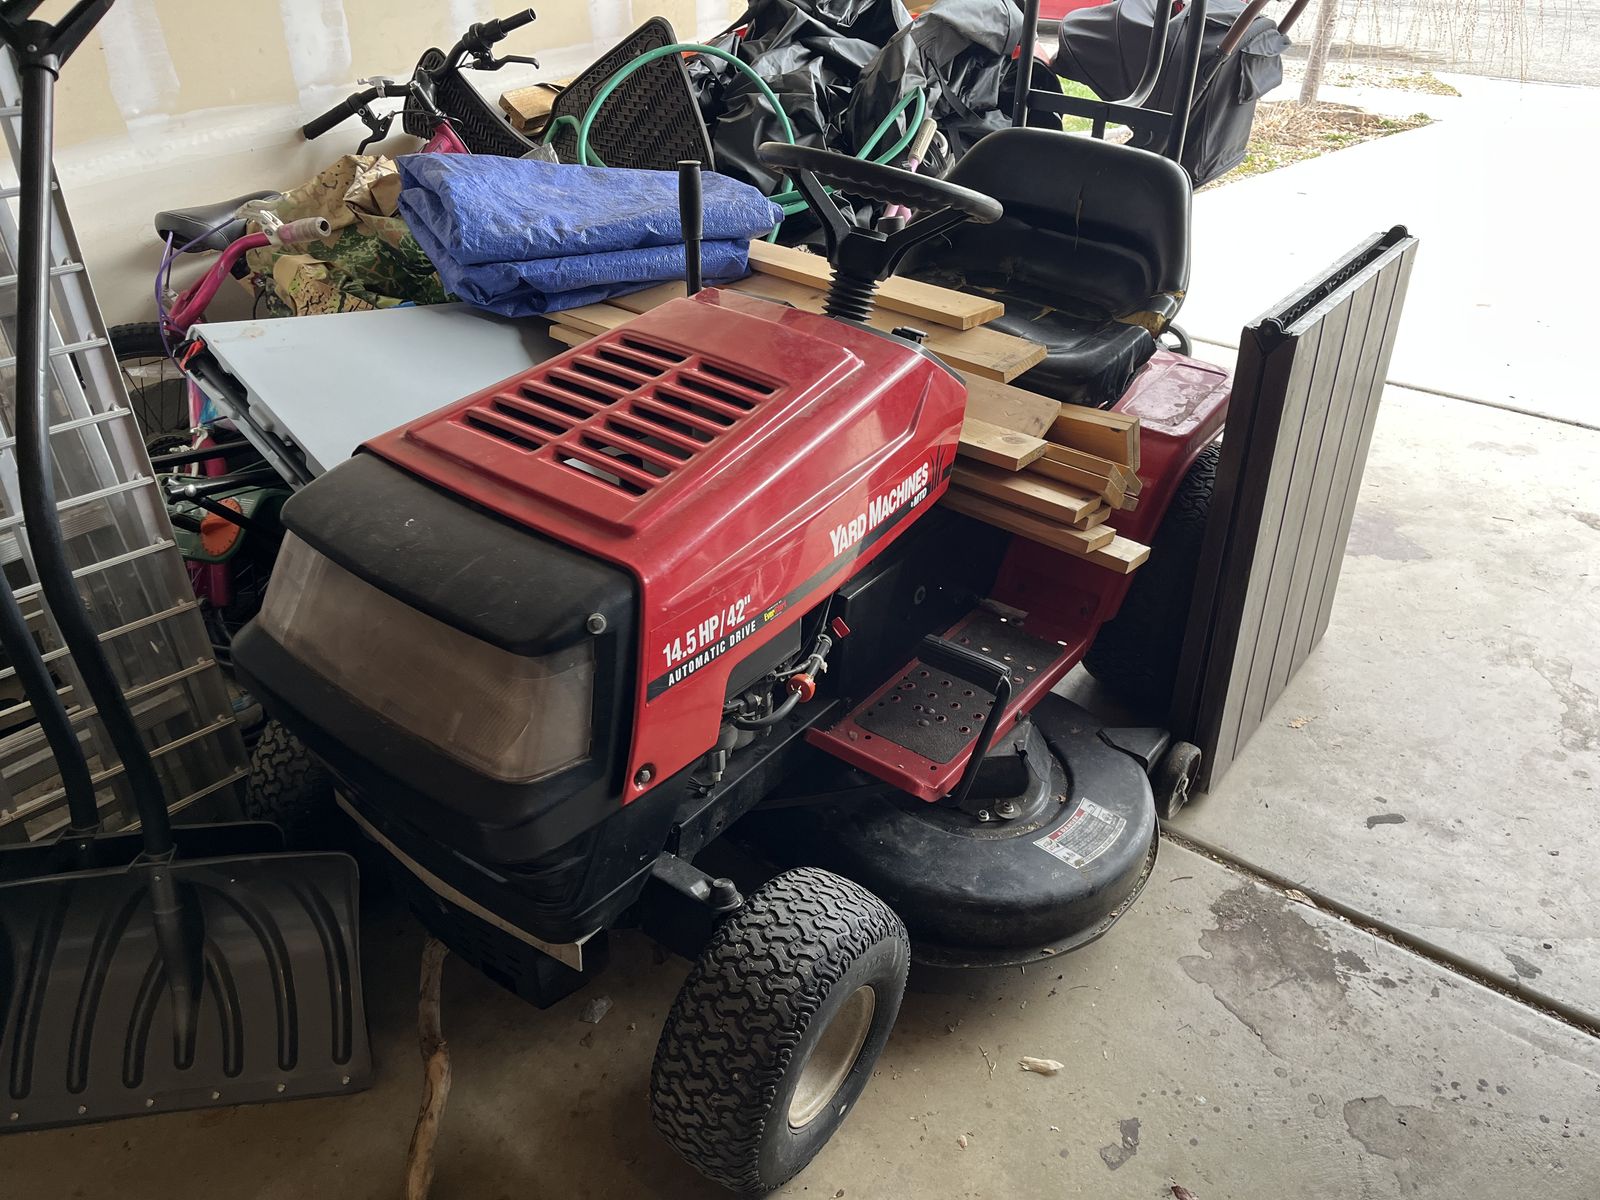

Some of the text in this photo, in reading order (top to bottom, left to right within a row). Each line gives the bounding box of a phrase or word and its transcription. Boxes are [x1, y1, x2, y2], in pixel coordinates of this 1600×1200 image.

[829, 462, 928, 557] YARD MACHINES
[662, 628, 697, 667] 14.5
[668, 620, 756, 686] AUTOMATIC DRIVE
